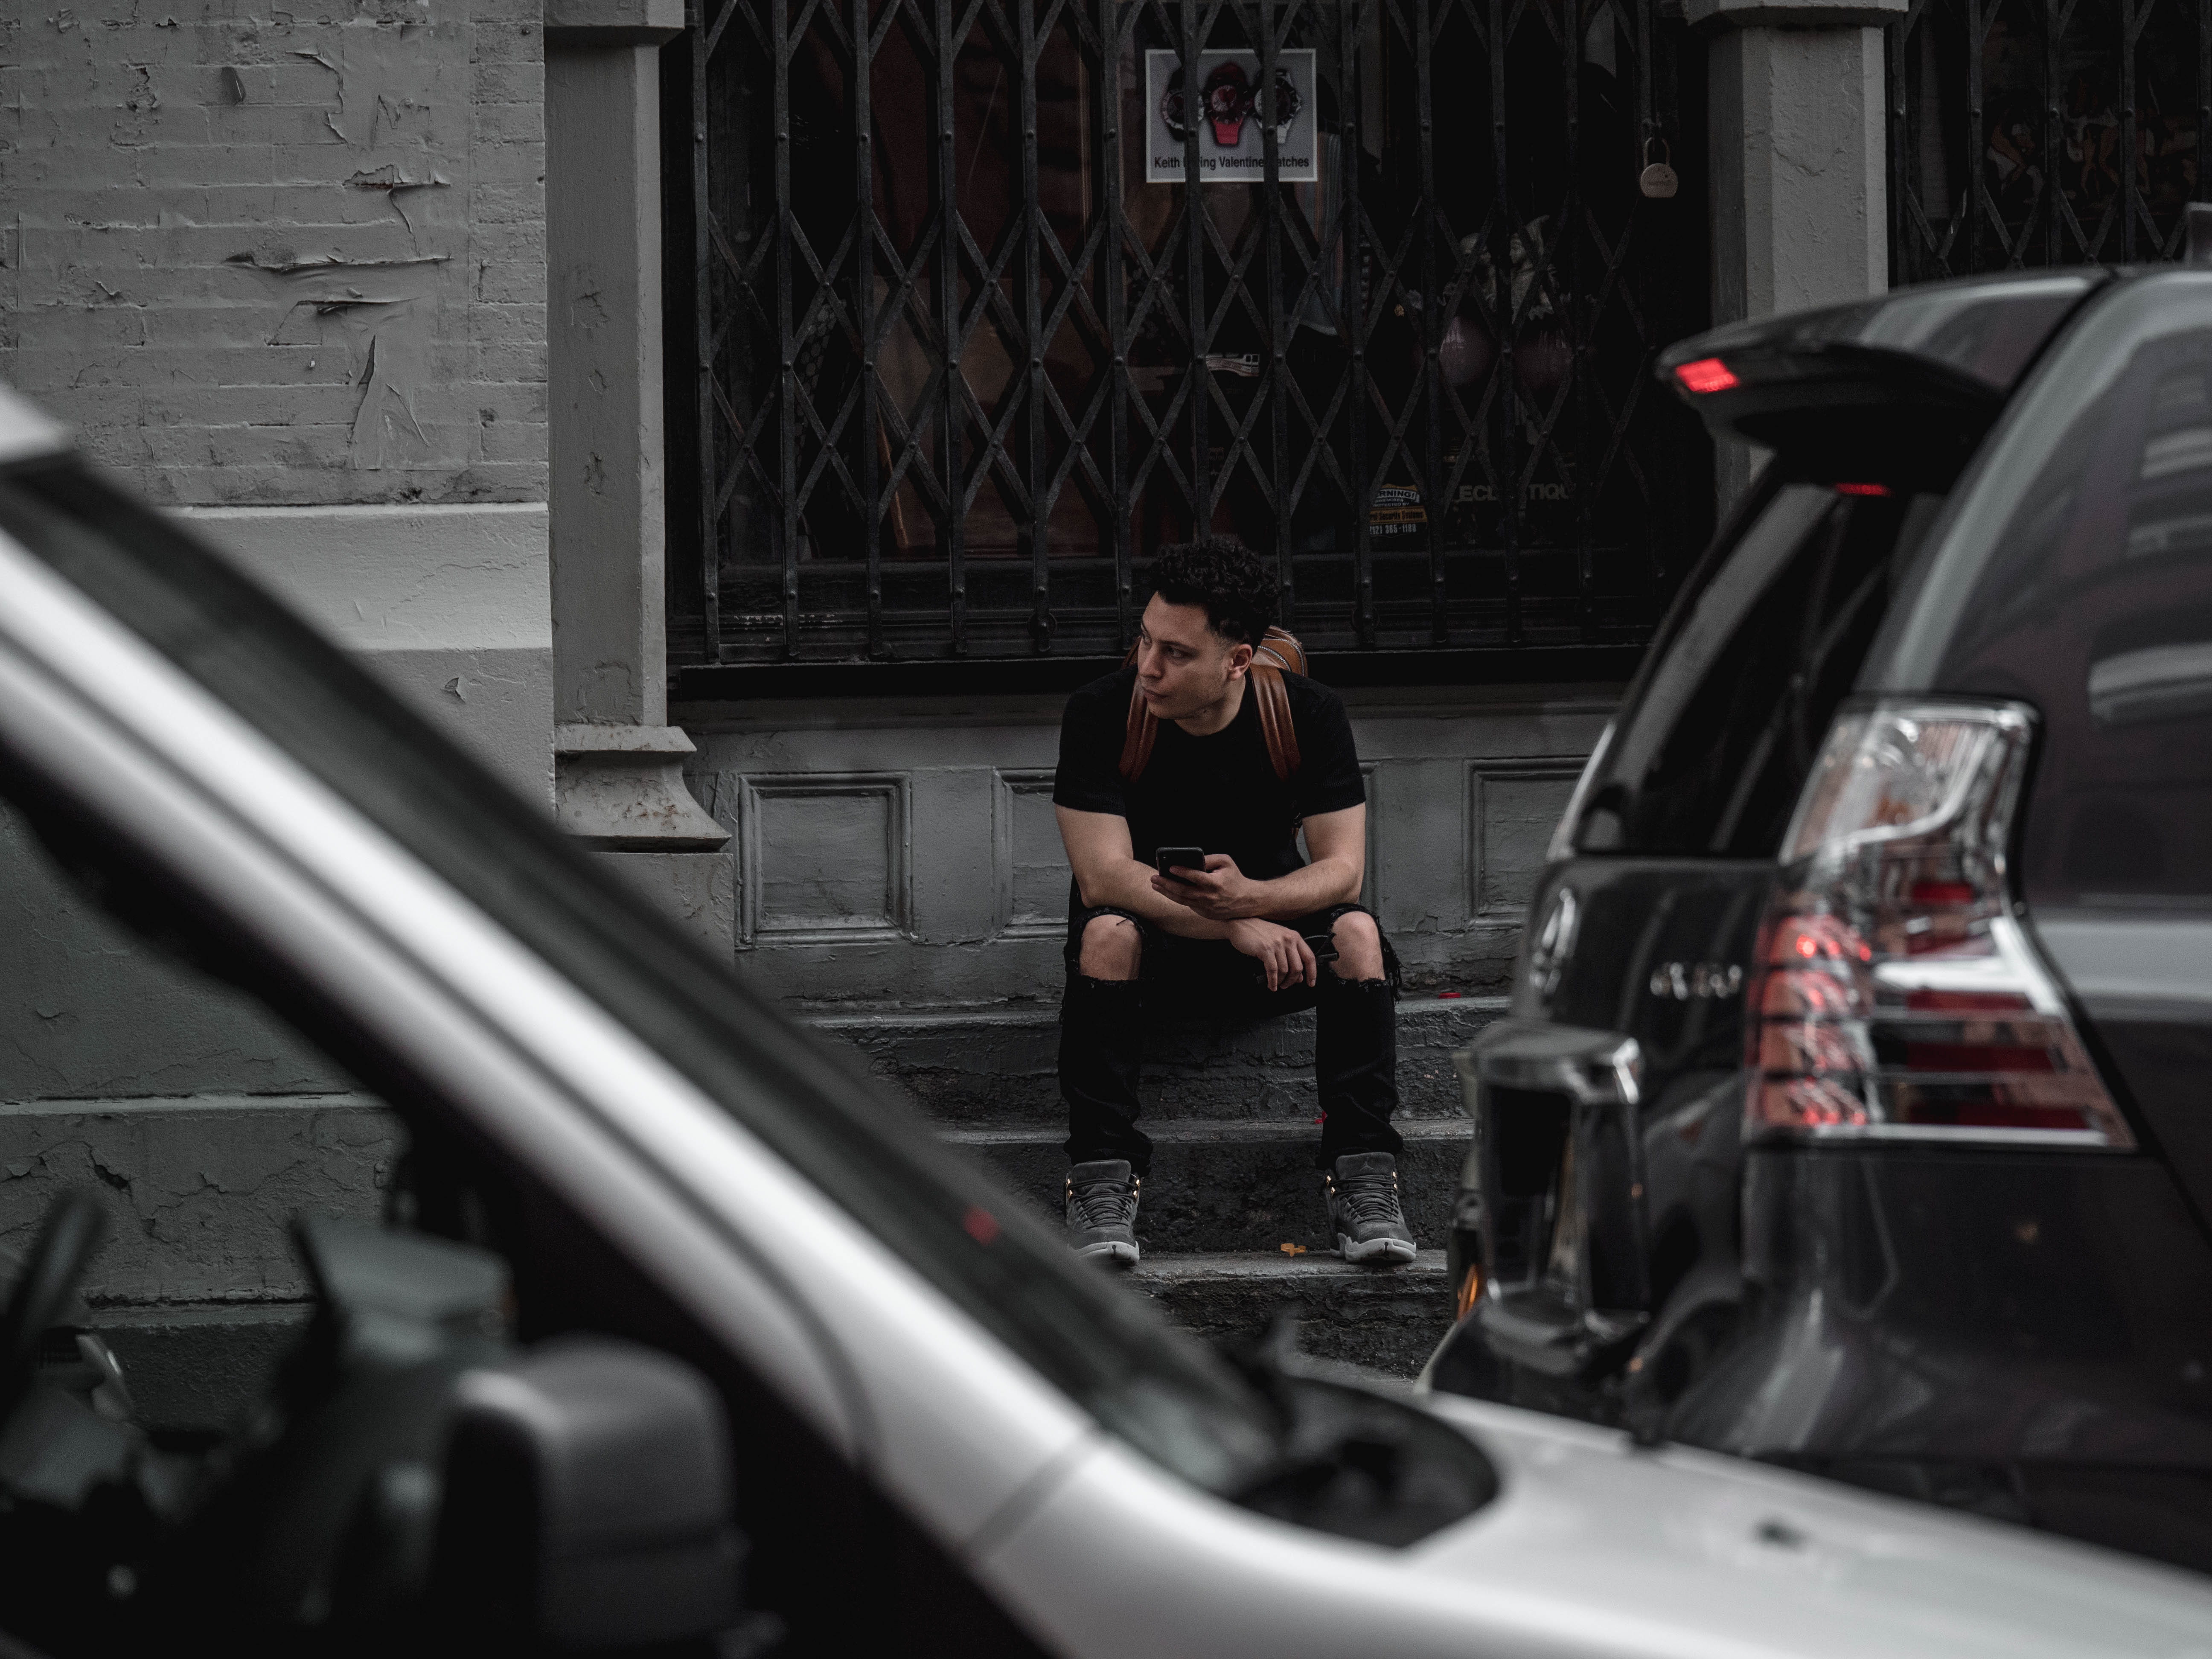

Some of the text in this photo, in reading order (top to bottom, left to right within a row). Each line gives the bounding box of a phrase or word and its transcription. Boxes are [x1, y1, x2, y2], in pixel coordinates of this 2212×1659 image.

[1154, 156, 1310, 170] Keith ing Valentine atches
[1380, 490, 1415, 499] RNING!
